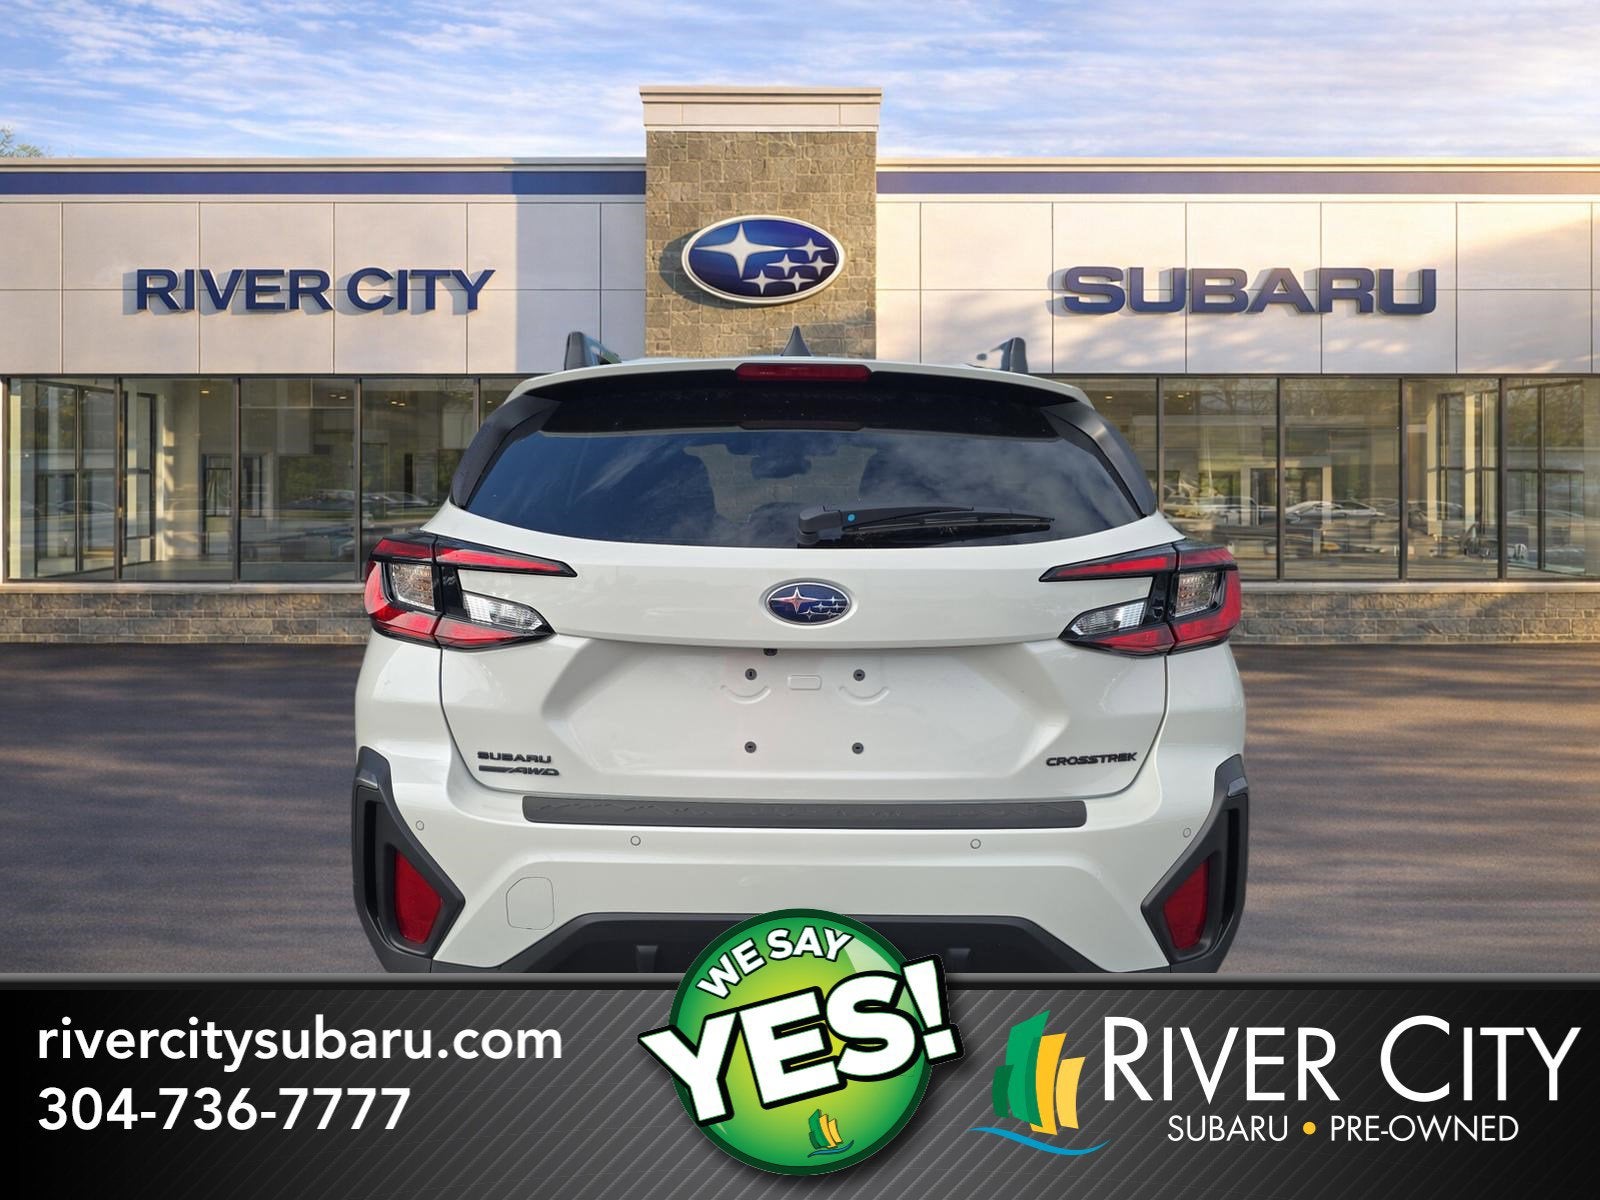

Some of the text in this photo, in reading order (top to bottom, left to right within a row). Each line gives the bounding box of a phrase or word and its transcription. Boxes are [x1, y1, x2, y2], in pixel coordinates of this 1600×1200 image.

[136, 267, 496, 311] RIVER CITY
[1063, 266, 1437, 315] SUBARU
[477, 751, 552, 763] SUBARU
[1046, 752, 1138, 766] CROSSTREK
[507, 766, 560, 776] AWD
